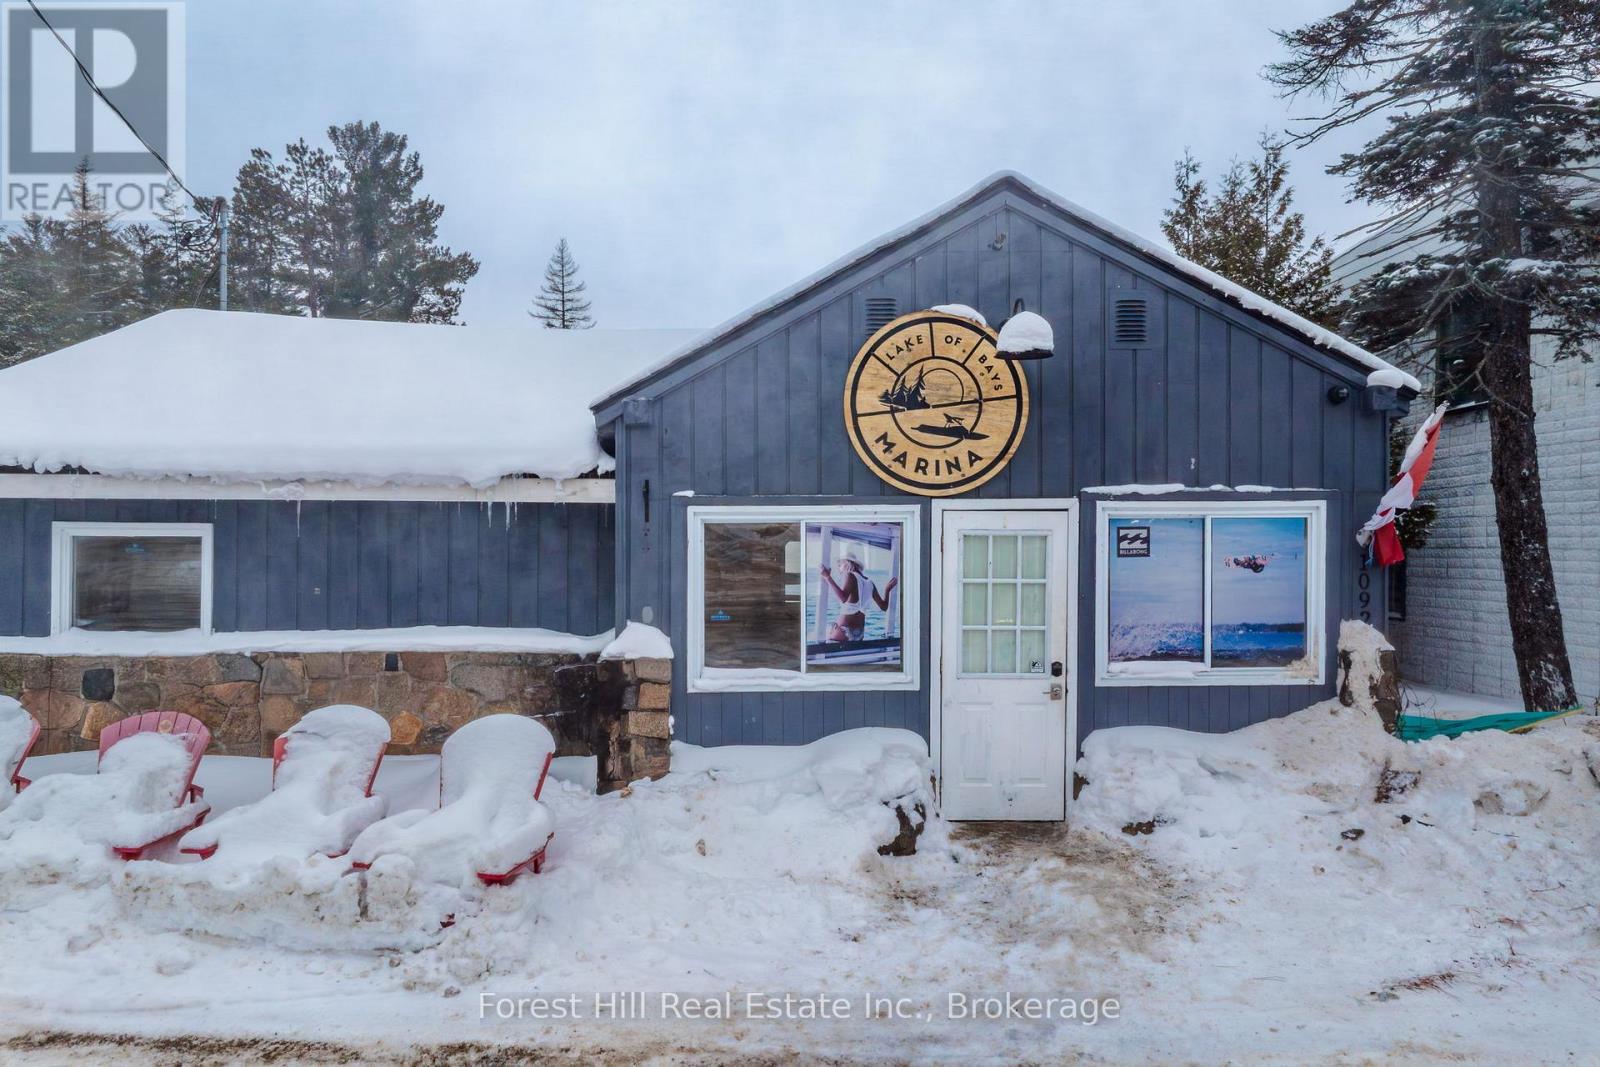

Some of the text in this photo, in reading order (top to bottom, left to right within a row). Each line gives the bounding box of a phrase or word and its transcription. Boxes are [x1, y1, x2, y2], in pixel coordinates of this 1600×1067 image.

[885, 334, 1003, 392] LAKE OF BAYS
[874, 431, 984, 476] MARINA
